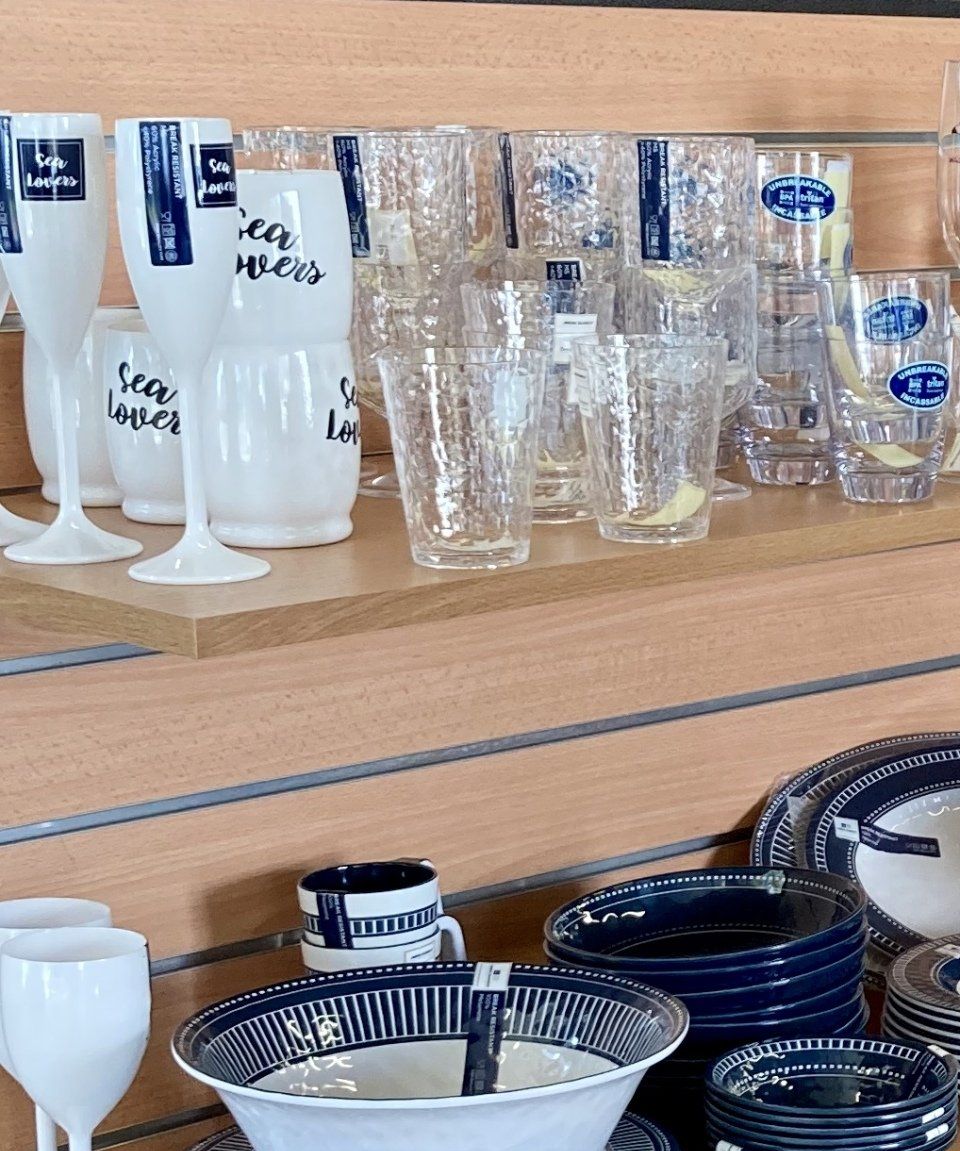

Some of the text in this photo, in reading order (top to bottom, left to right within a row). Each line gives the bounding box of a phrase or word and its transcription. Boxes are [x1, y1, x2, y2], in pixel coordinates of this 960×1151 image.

[35, 152, 69, 169] Sea
[208, 158, 232, 175] Sea
[171, 156, 184, 200] RESISTANT
[771, 203, 827, 220] INCASAE
[117, 361, 179, 406] Sea
[107, 388, 181, 436] Lover
